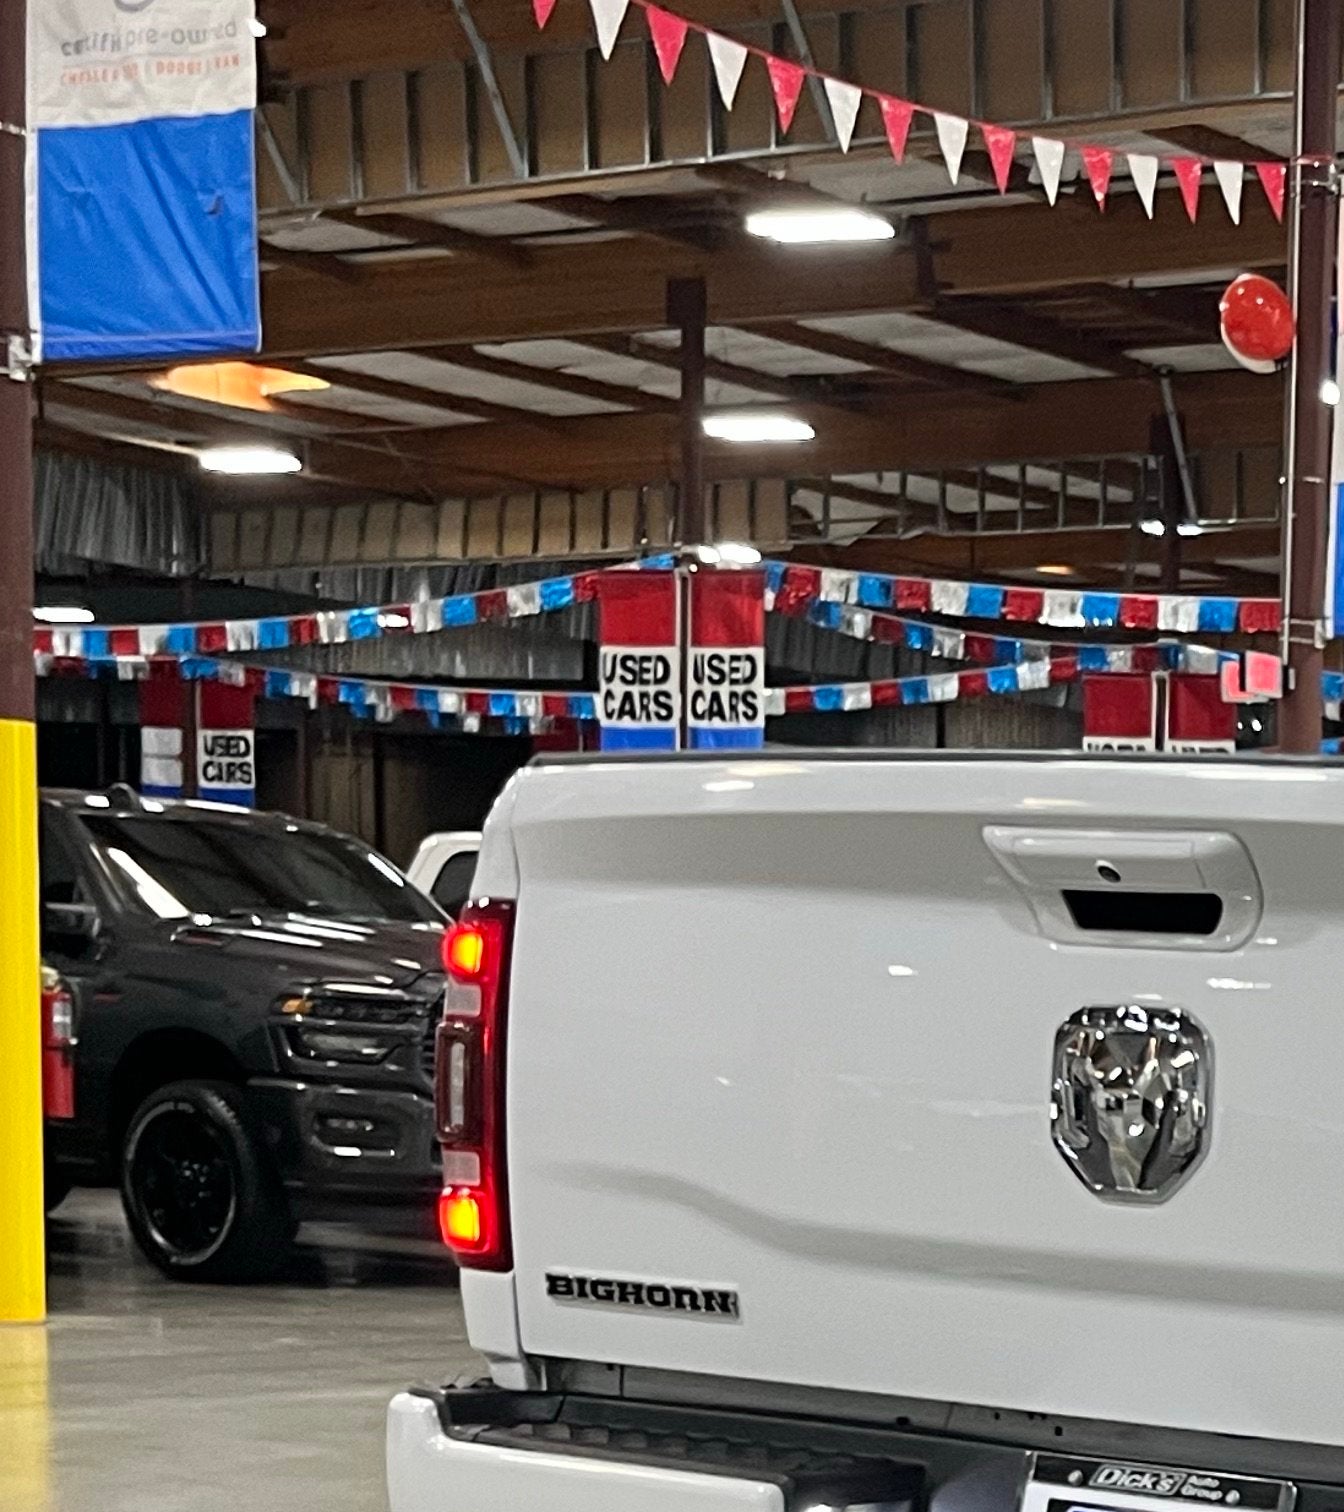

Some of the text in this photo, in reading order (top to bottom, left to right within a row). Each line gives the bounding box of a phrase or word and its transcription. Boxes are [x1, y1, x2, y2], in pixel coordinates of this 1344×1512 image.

[603, 653, 671, 686] USED
[693, 653, 757, 686] USED
[604, 689, 673, 721] CARS
[691, 689, 758, 722] CARS
[203, 735, 250, 758] USED
[545, 1273, 740, 1320] BIGHORN
